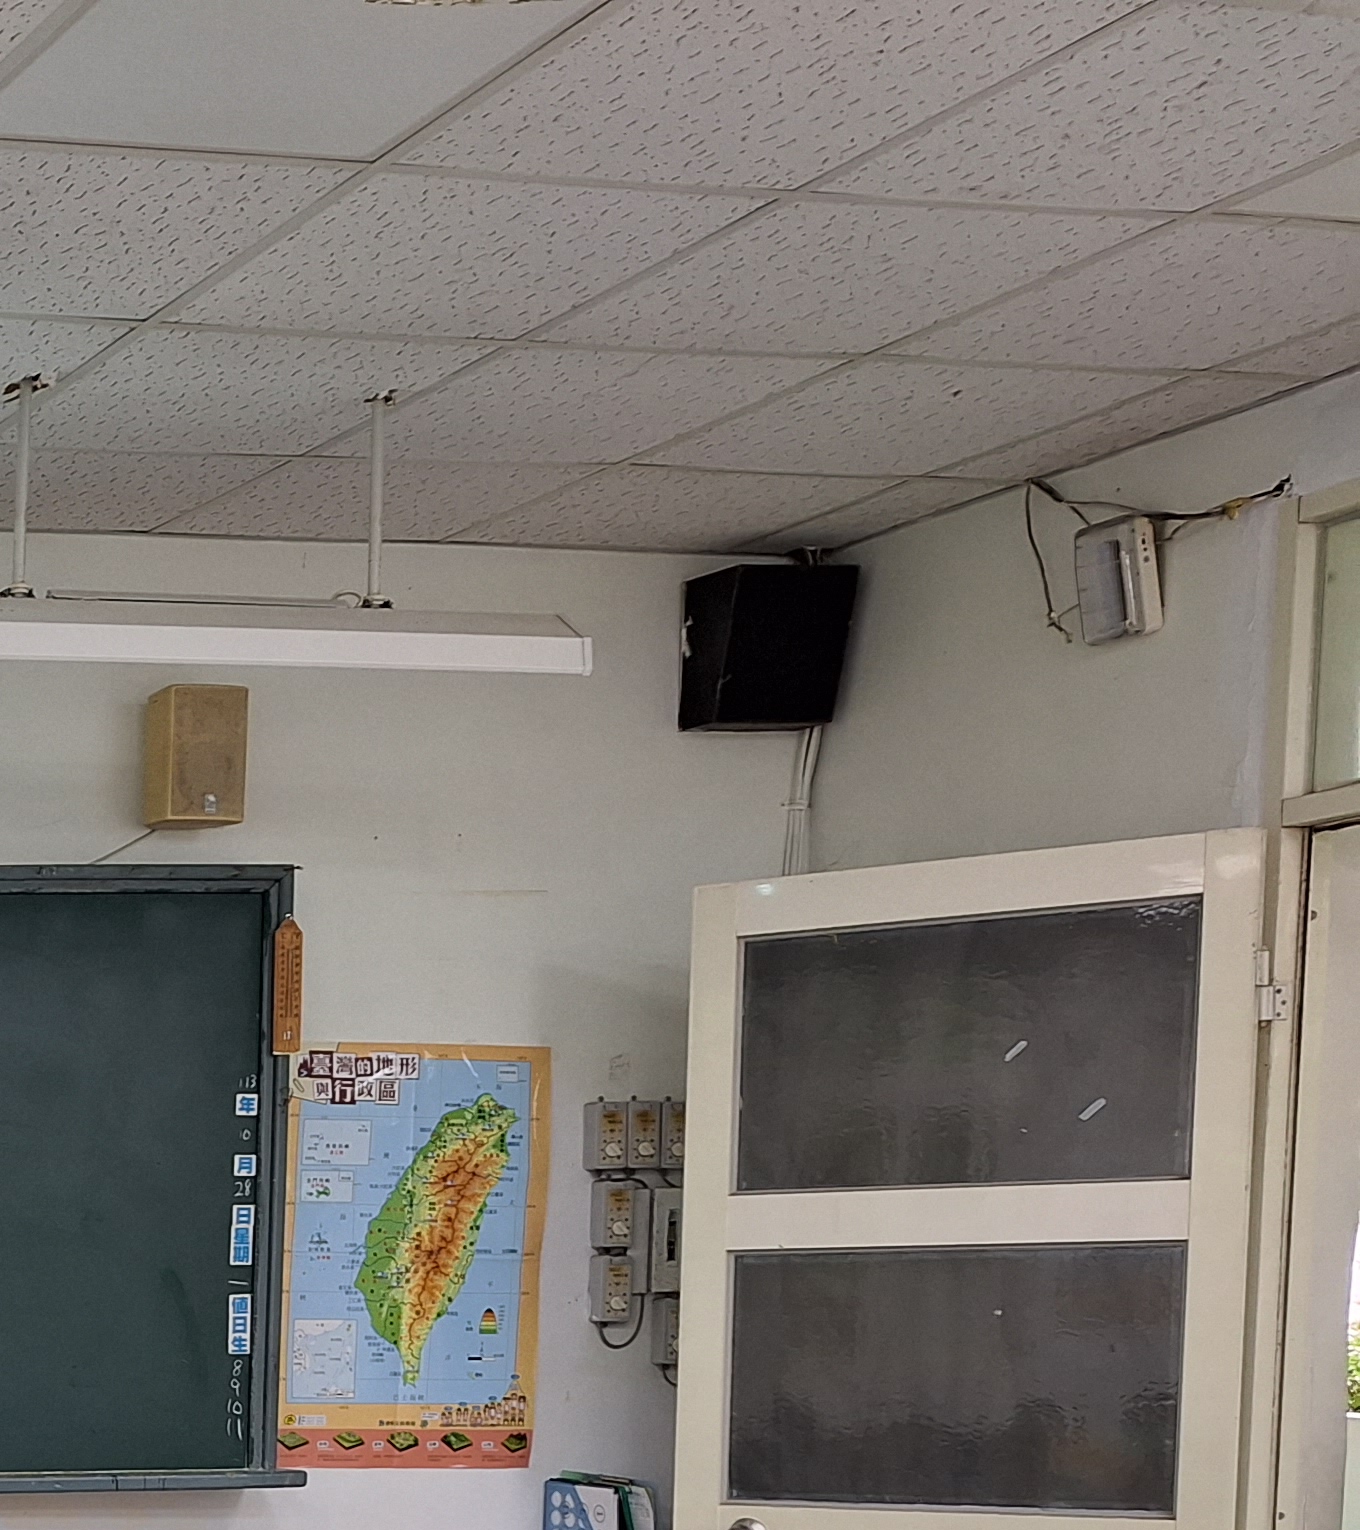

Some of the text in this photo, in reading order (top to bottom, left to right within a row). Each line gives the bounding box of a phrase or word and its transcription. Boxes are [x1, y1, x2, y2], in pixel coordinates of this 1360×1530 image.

[311, 1052, 418, 1076] 臺灣的地形
[316, 1079, 398, 1104] 與行政區
[238, 1095, 256, 1114] 年
[237, 1156, 253, 1174] 月
[233, 1178, 252, 1197] 28
[231, 1297, 249, 1353] 值日生
[232, 1359, 243, 1377] 8
[230, 1378, 241, 1397] 9
[227, 1398, 243, 1415] 10
